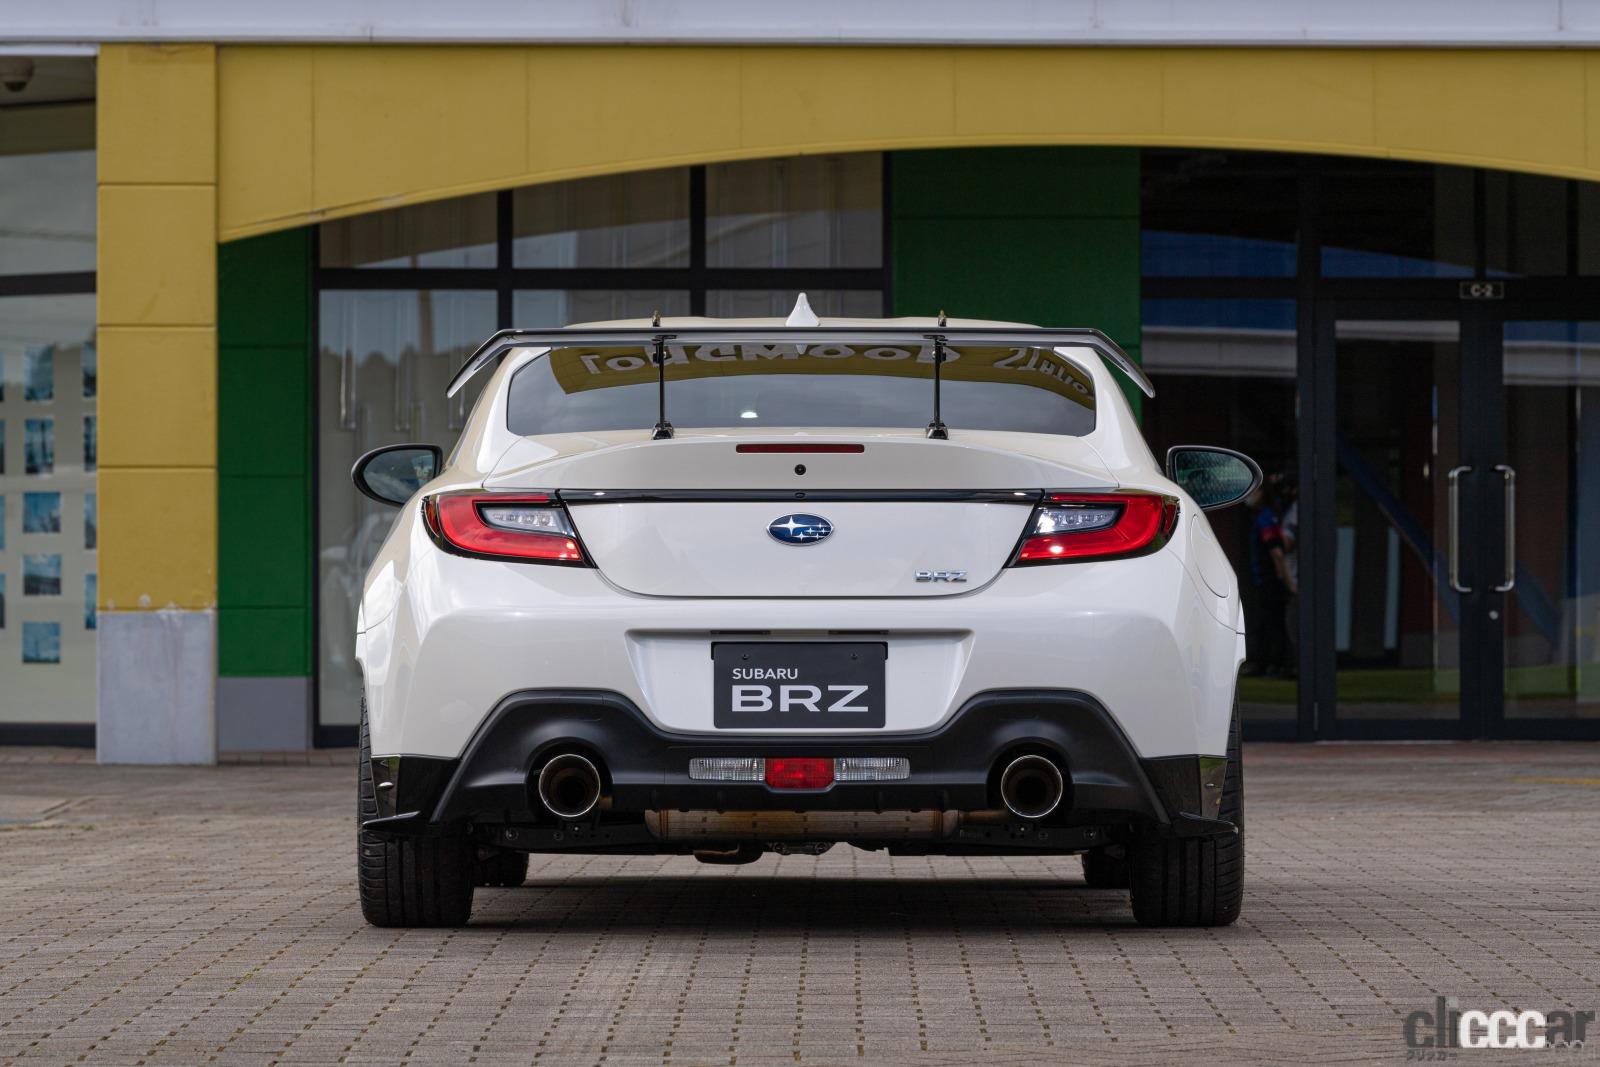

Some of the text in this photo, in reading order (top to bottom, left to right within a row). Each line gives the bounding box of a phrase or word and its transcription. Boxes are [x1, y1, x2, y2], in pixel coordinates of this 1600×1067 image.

[1470, 283, 1493, 298] C-2
[915, 570, 967, 583] BRZ
[732, 668, 799, 680] SUBARU
[731, 684, 869, 712] BRZ
